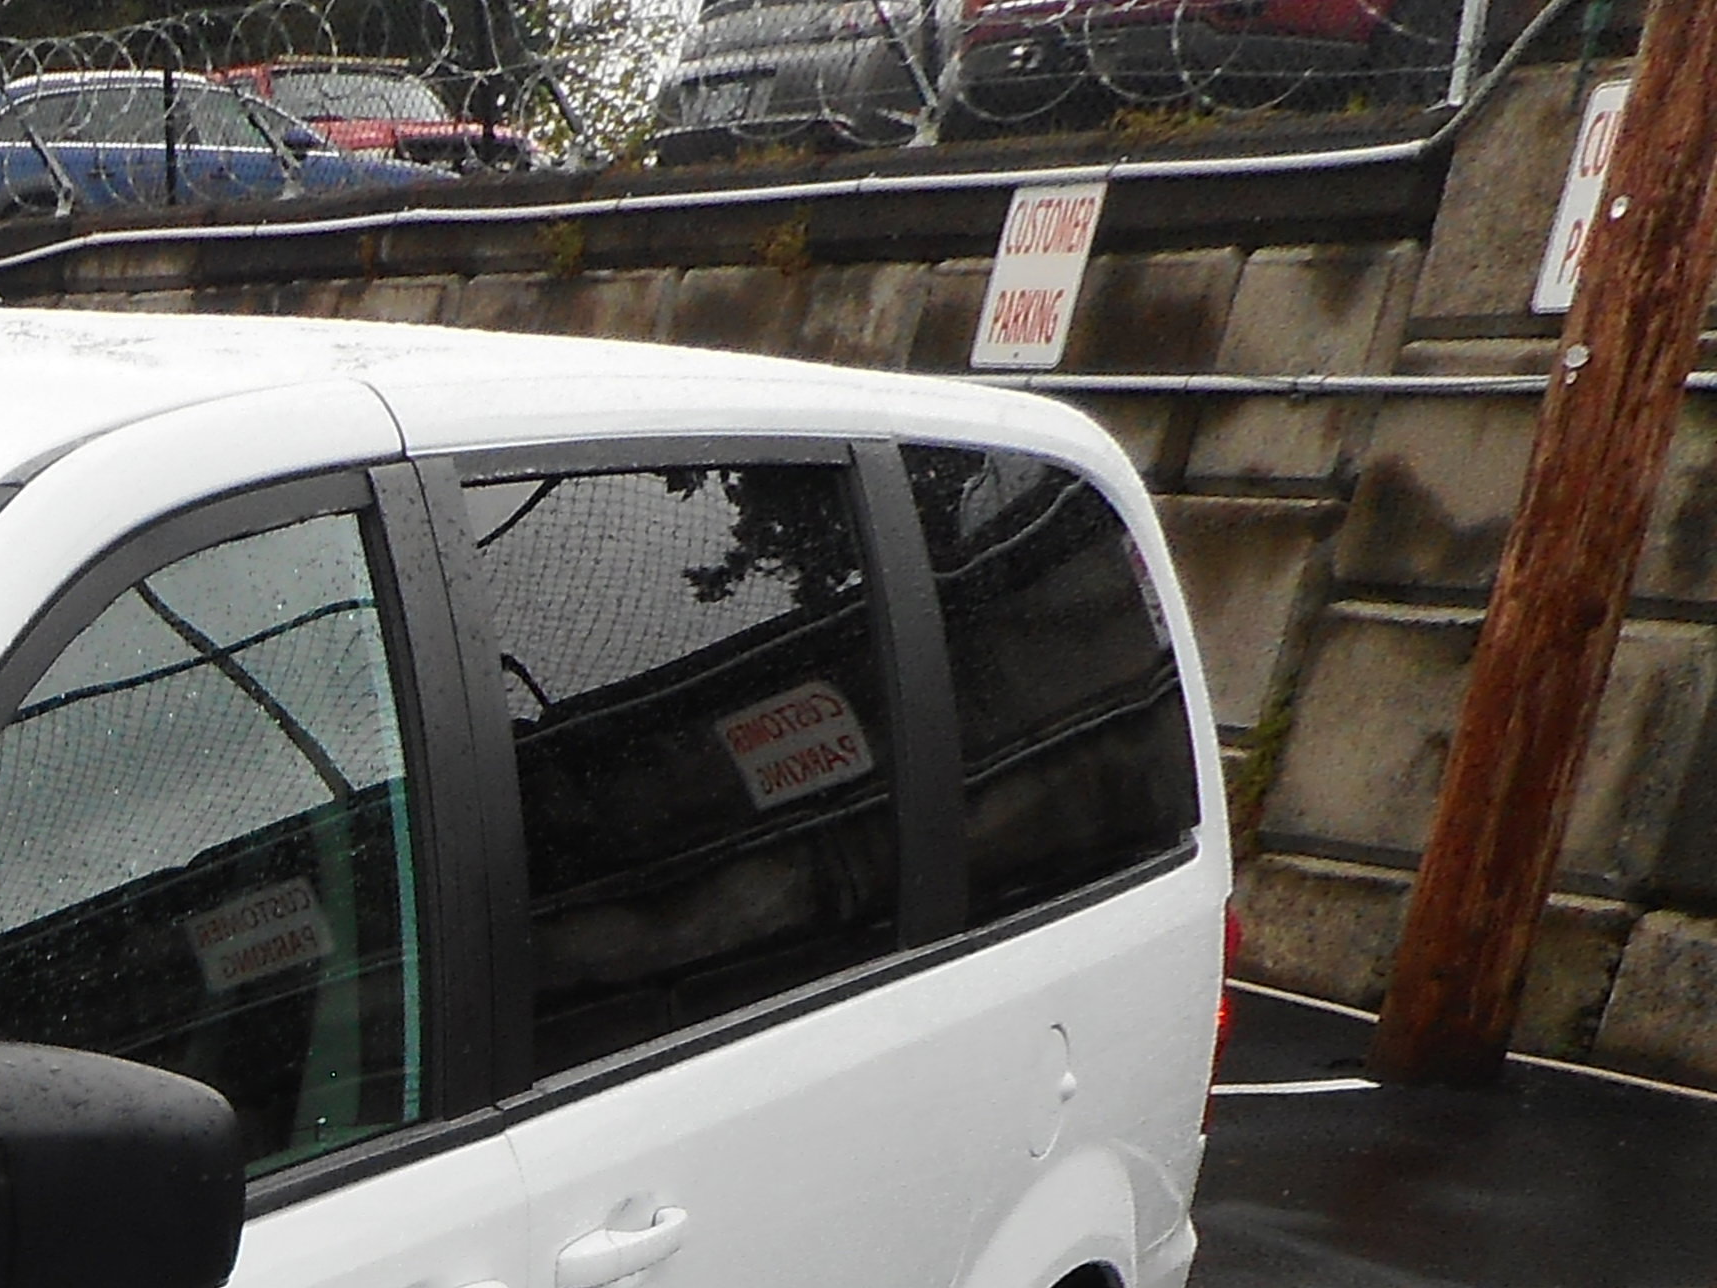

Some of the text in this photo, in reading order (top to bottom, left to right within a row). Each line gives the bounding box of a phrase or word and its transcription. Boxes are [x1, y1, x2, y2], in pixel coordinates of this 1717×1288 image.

[1003, 197, 1097, 254] CUSTOMER
[1557, 220, 1583, 285] P
[987, 288, 1064, 344] PARKING
